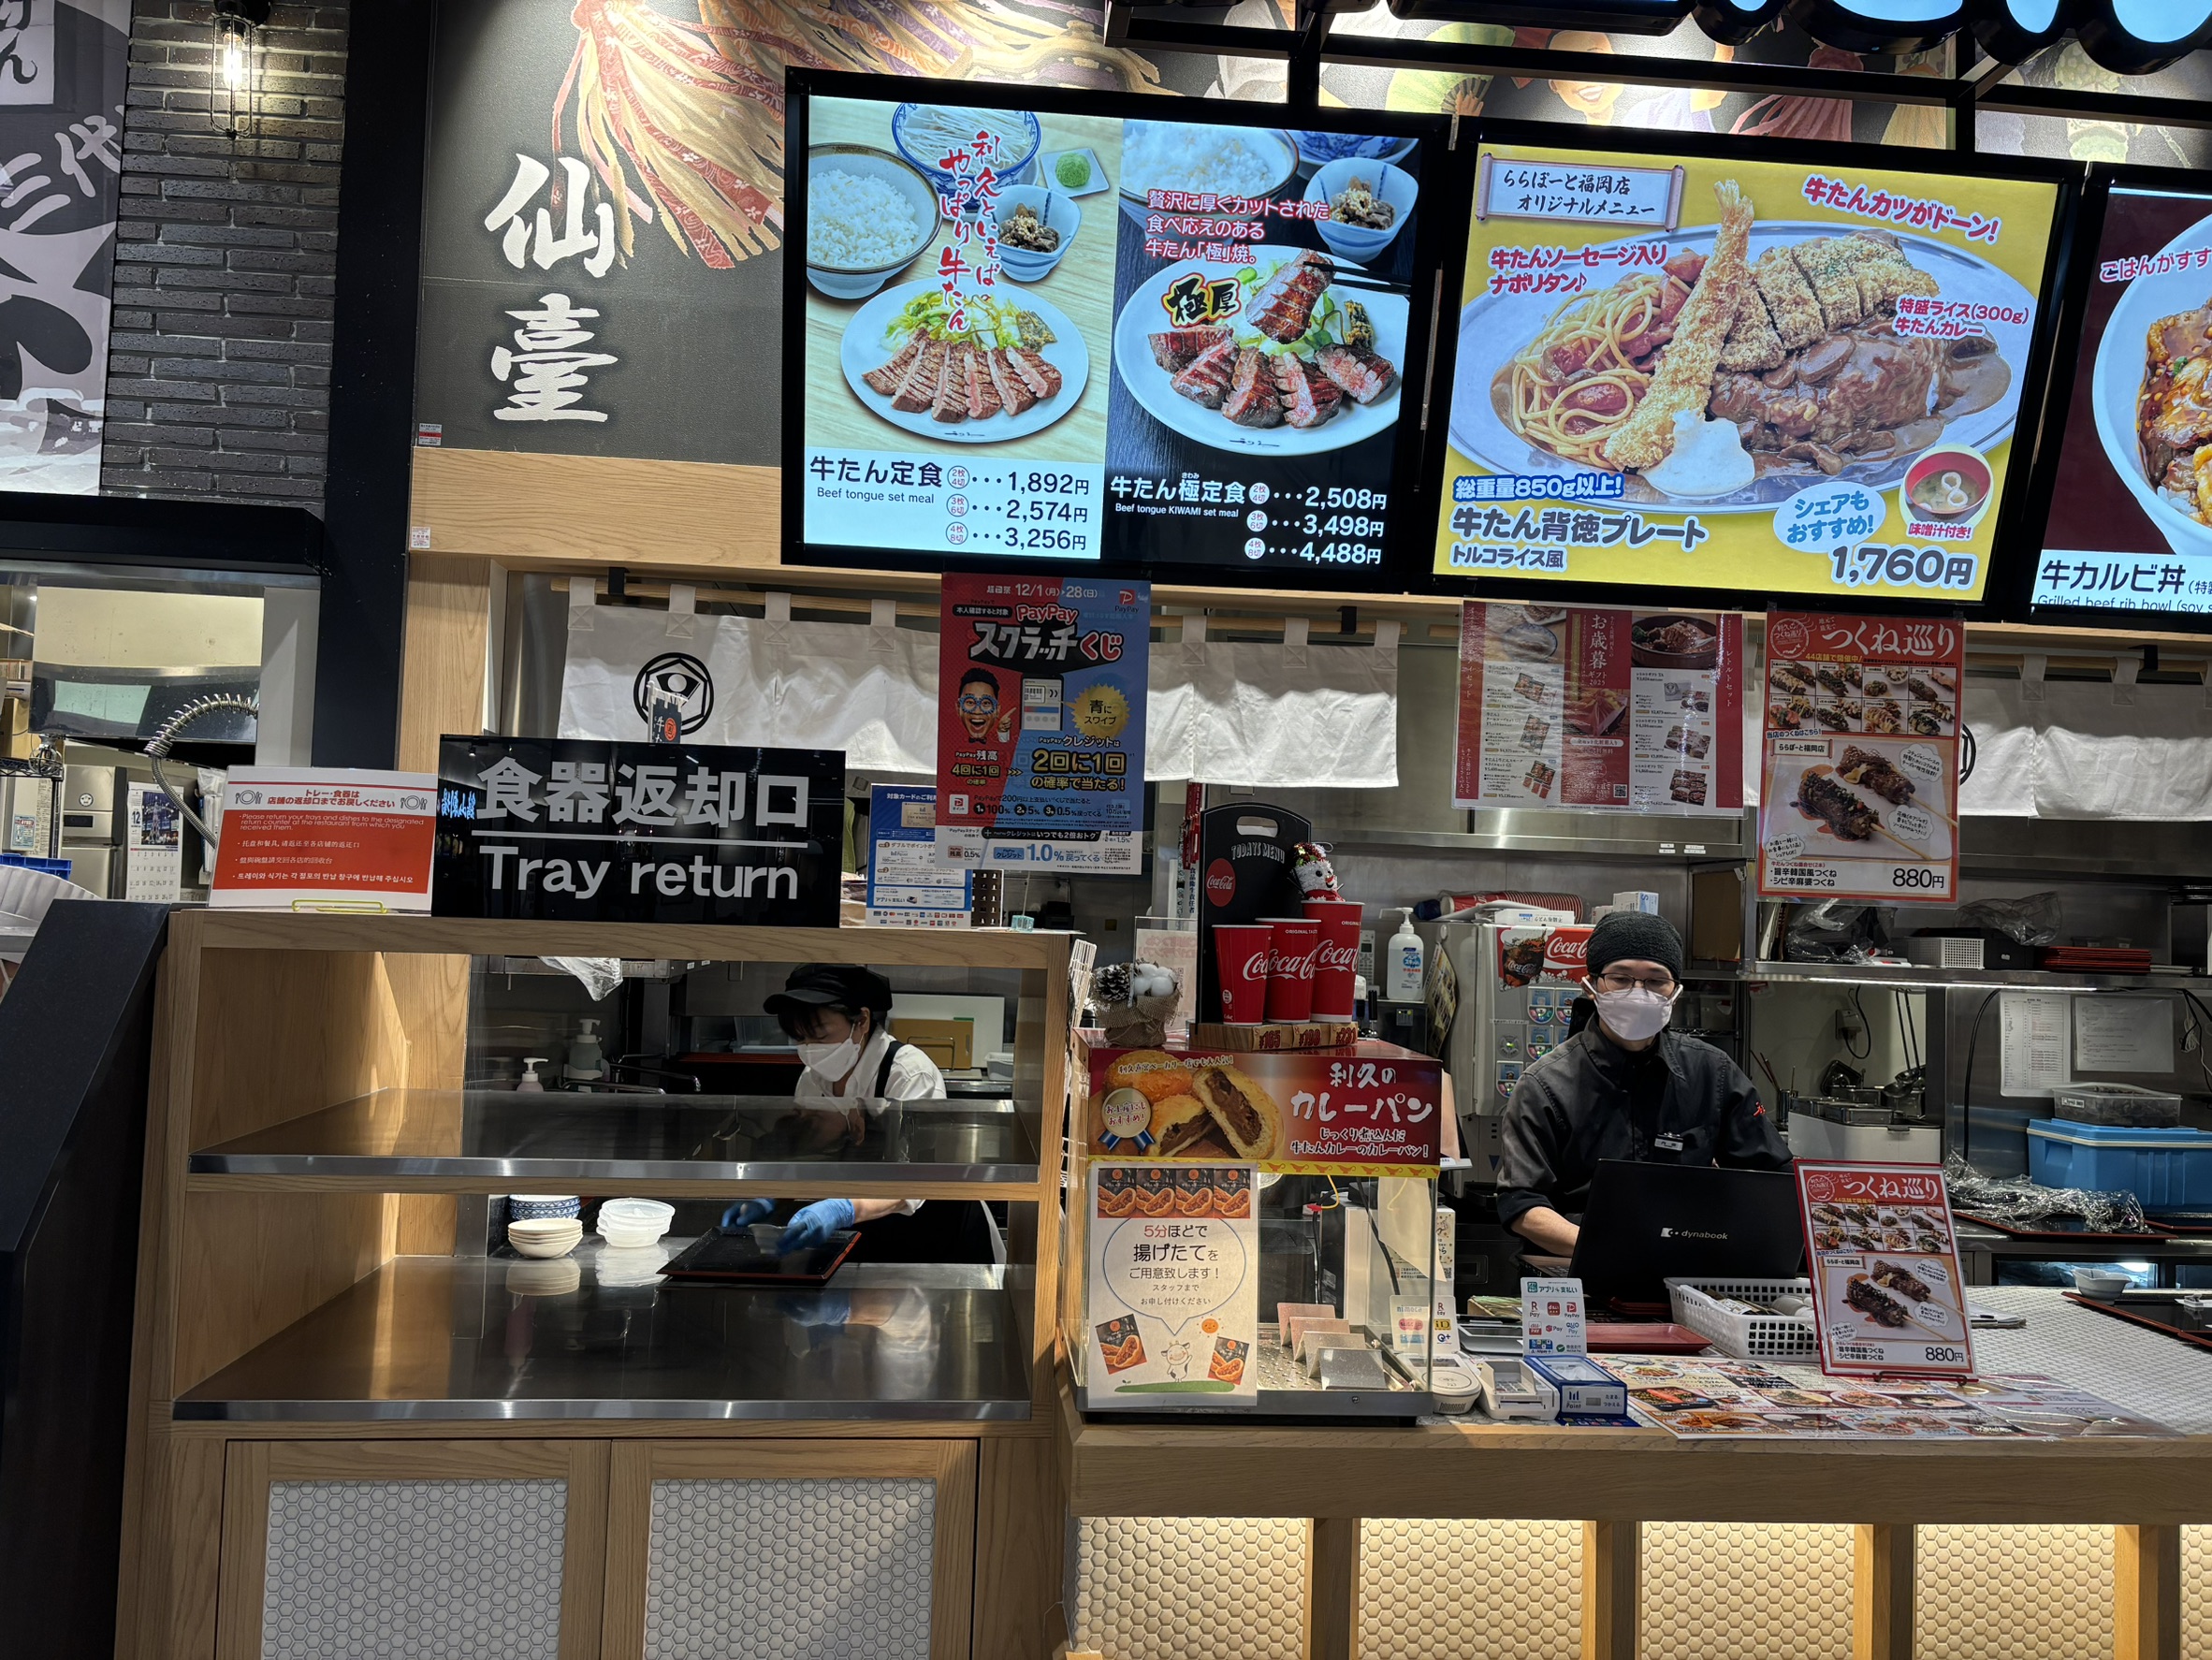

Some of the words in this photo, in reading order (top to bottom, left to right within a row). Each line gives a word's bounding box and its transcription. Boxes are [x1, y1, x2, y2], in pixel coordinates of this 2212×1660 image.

[1503, 169, 1631, 196] ららぽーと福岡店
[1148, 189, 1331, 221] 贅沢に厚くカットされた
[1517, 194, 1655, 215] オリジナルメニュー
[1804, 177, 1999, 242] 牛たんカツがドーン!
[1146, 213, 1265, 240] 食べ応えのある
[938, 148, 971, 331] やっぱり牛たん
[1145, 239, 1257, 264] 牛たん「極」焼。
[1490, 244, 1667, 270] 牛たんソーセージ入り
[1166, 277, 1237, 323] 極厚
[1899, 298, 2030, 325] 特盛ライス(300g)
[1895, 317, 1984, 337] 牛たんカレー
[809, 455, 943, 488] 牛たん定食
[817, 487, 842, 499] Beef
[846, 489, 884, 502] tongue
[888, 491, 905, 502] set
[909, 492, 935, 503] meal
[1008, 472, 1089, 496] 1,892円
[1110, 476, 1246, 504] 牛たん極定食
[1456, 476, 1622, 500] 総重量850g以上!
[1115, 502, 1135, 512] Beef
[1137, 504, 1166, 516] tongue
[1169, 505, 1201, 516] KIWAMI
[1203, 507, 1216, 517] set
[1218, 508, 1239, 517] meal
[1304, 487, 1387, 511] 2,508円
[1794, 490, 1870, 519] シェアも
[1006, 499, 1087, 523] 2,574円
[1302, 514, 1384, 538] 3,498円
[1452, 507, 1706, 549] 牛たん背徳プレート
[1786, 515, 1874, 544] おすすめ!
[1908, 523, 1972, 539] 味噌汁付き!
[1004, 527, 1086, 550] 3,256円
[1300, 542, 1381, 565] 4,488円
[1453, 546, 1564, 569] トルコライス風
[1832, 546, 1973, 586] 1,760円
[2041, 560, 2186, 595] 牛カルビ丼
[1114, 604, 1140, 613] PayPay
[2037, 594, 2080, 606] Grilled
[2086, 597, 2116, 608] beef
[2119, 598, 2135, 609] rib
[2141, 599, 2172, 611] bowl
[1016, 604, 1078, 625] PayPay
[969, 622, 1124, 661] スクラッチくじ
[1822, 620, 1956, 659] つくね巡り
[1089, 700, 1112, 714] 青に
[1084, 716, 1116, 725] スワイプ
[1038, 735, 1121, 748] PayPayクレジットは
[1766, 729, 1822, 739] 当店のつくねはこちら!
[955, 750, 998, 762] PayPay残高
[1778, 743, 1826, 753] ららぽーと福岡店
[951, 764, 1000, 777] 4回に1回
[1031, 748, 1127, 776] 2回に1回
[305, 789, 360, 798] トレー・食器は
[475, 756, 810, 829] 食器返却口
[1031, 777, 1126, 791] の確率で当たる!
[267, 796, 396, 808] 店舗の返却口までお戻しください
[384, 817, 424, 826] designated
[1262, 842, 1286, 865] MENU
[385, 875, 414, 883] 주십시오
[478, 845, 612, 900] Tray
[630, 855, 798, 900] return
[1892, 868, 1944, 889] 880円
[1330, 1062, 1397, 1089] 利久の
[1290, 1091, 1433, 1124] カレーパン
[1108, 1113, 1146, 1126] おすすめ!
[1318, 1127, 1405, 1143] じっくり煮込んだ
[1289, 1141, 1430, 1158] 牛たんカレーのカレーパン!
[1843, 1175, 1940, 1201] つくね巡り
[1143, 1224, 1208, 1239] 5分ほどで
[1681, 1230, 1728, 1240] dynabook
[1133, 1244, 1219, 1263] 揚げたてを
[1128, 1267, 1220, 1280] ご用意致します!
[1152, 1284, 1200, 1292] スタッフまで
[1141, 1297, 1212, 1306] お申し付けください
[1925, 1347, 1964, 1362] 880円
